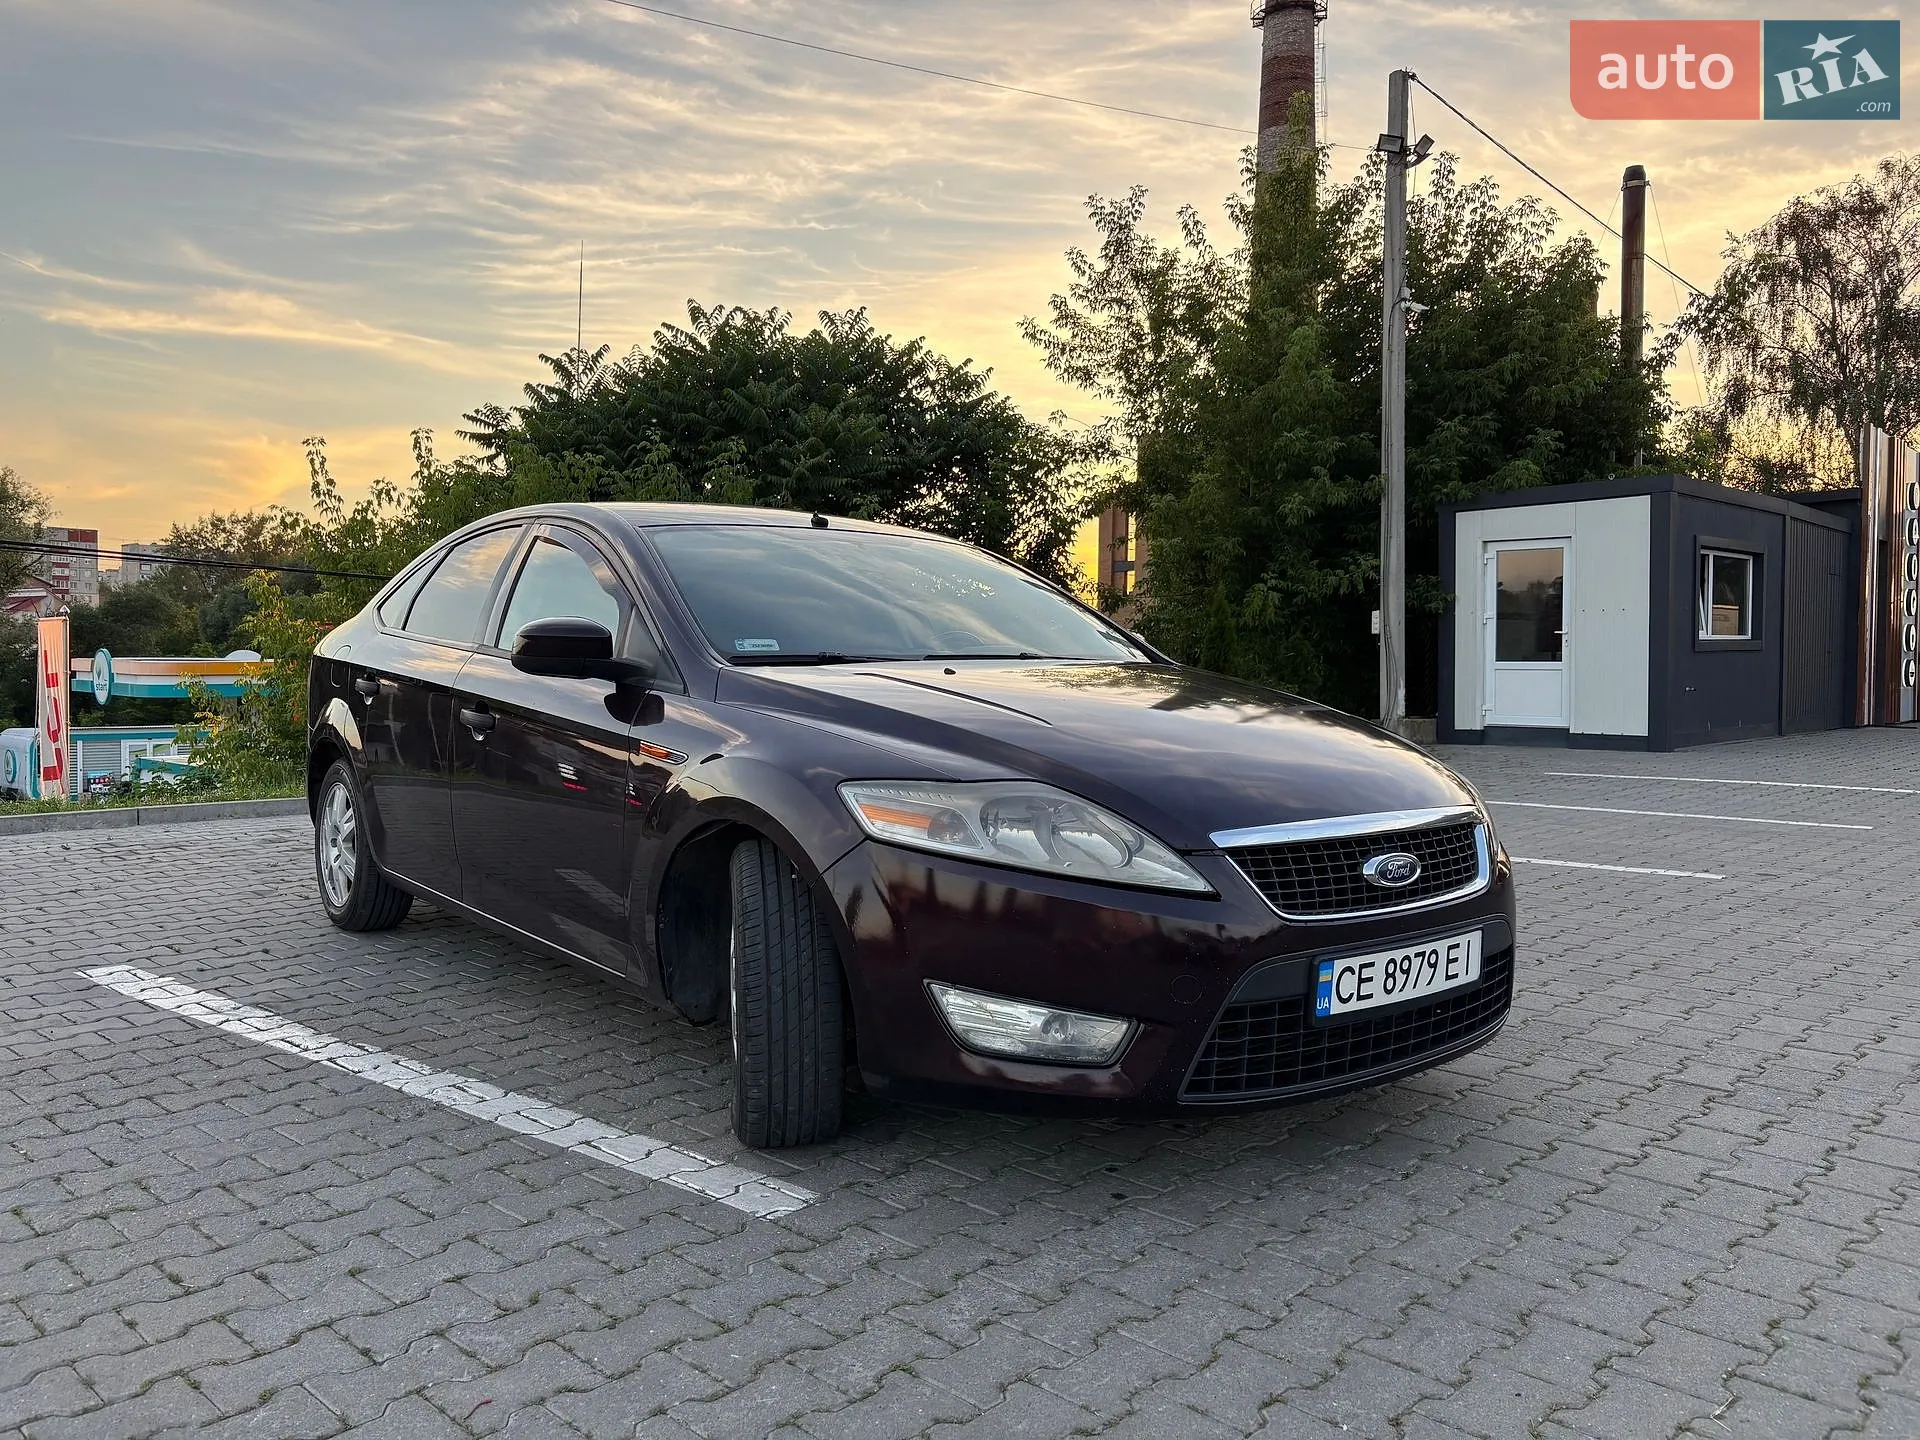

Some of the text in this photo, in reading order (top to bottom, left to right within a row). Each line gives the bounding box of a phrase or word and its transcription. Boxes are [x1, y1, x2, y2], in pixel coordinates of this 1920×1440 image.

[1386, 860, 1410, 879] Ford
[1335, 939, 1471, 1005] CE 8979 EI
[1316, 997, 1330, 1010] UA
